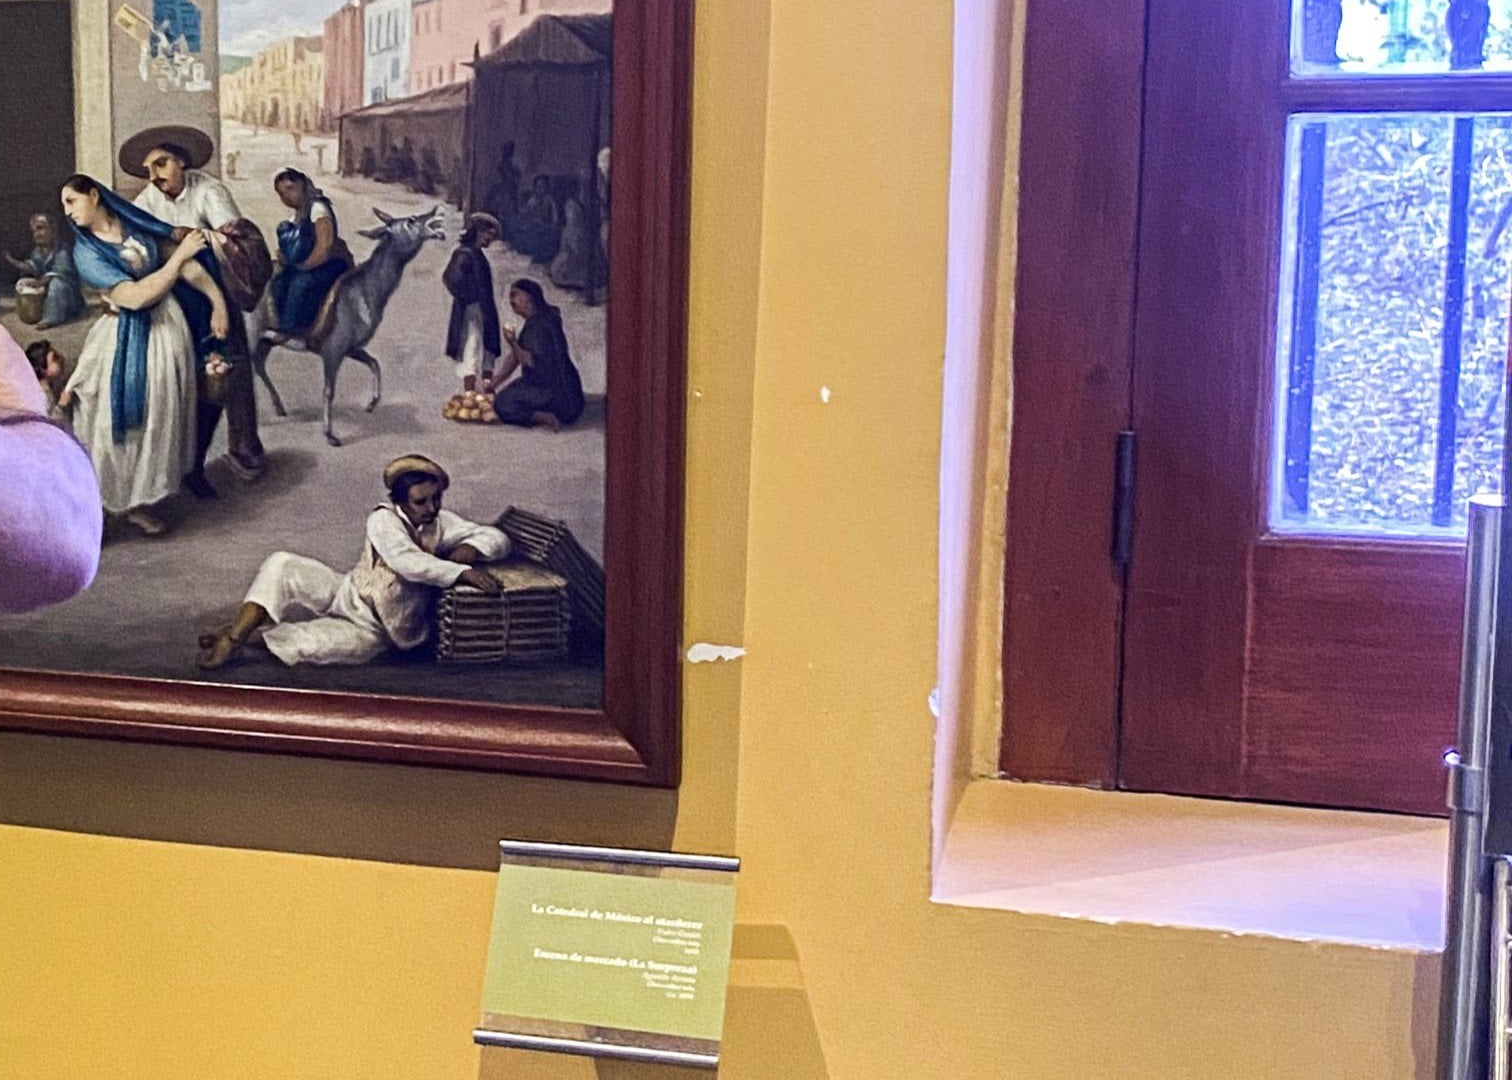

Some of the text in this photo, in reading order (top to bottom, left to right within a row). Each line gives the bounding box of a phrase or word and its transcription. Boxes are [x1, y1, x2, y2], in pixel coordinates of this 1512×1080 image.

[531, 903, 544, 914] La
[545, 904, 589, 919] Catedral
[589, 909, 604, 920] de
[642, 915, 654, 925] al
[569, 952, 583, 962] de
